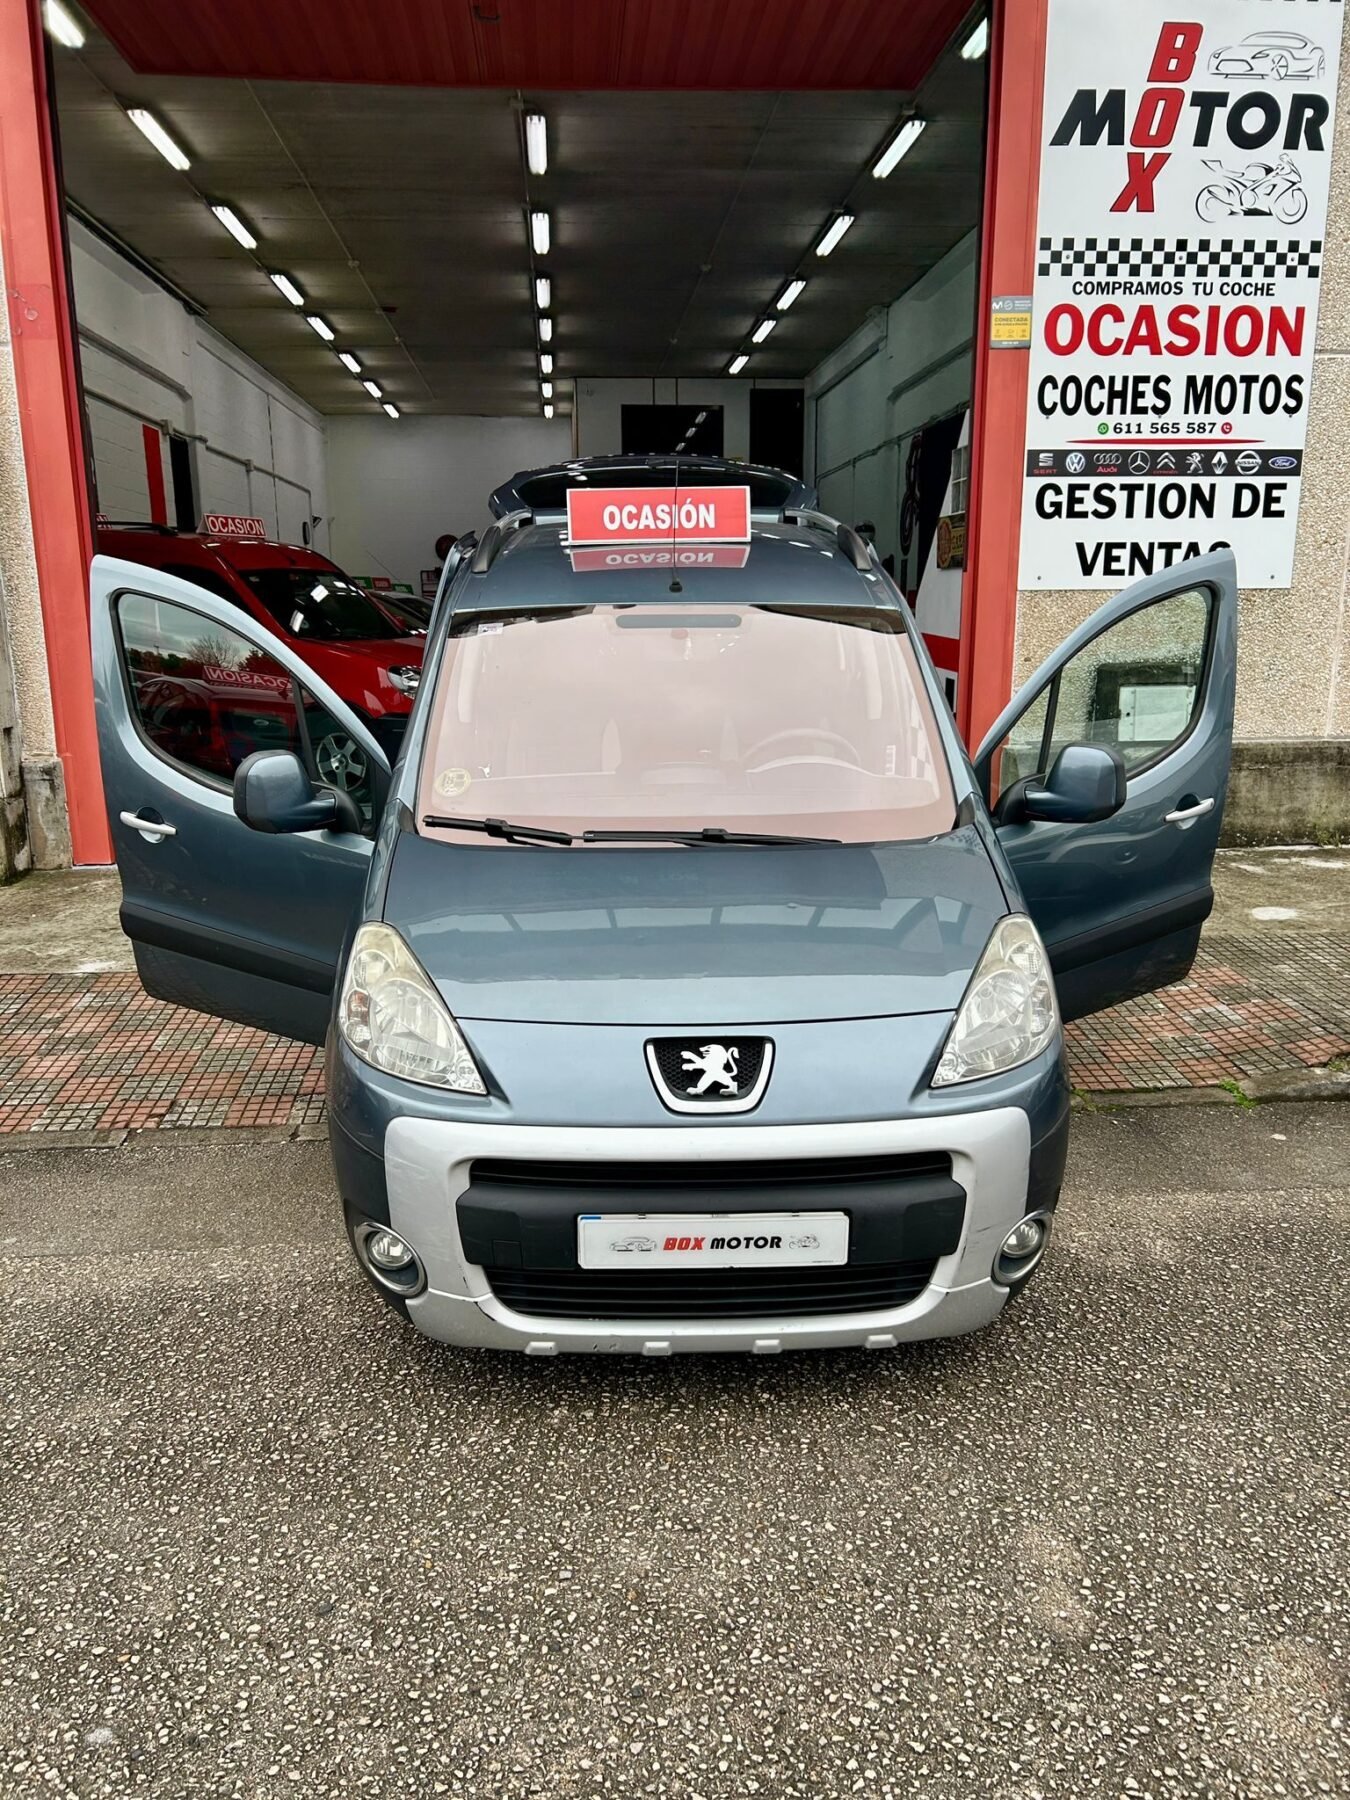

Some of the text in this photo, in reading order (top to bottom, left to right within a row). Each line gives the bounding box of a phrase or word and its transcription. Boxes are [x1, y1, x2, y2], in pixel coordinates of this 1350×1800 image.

[1049, 88, 1330, 151] MOTOR
[1109, 22, 1204, 213] BOX
[1072, 281, 1276, 297] COMPRAMOS TU COCHE
[1043, 303, 1306, 357] OCASION
[1037, 374, 1304, 416] COCHES MOTOS
[1113, 423, 1216, 434] 611 565 587
[1274, 459, 1292, 467] Ford
[603, 498, 716, 530] OCASIÓN
[1035, 483, 1288, 519] GESTION DE
[208, 516, 264, 535] OCASION
[663, 1236, 783, 1251] BOX MOTOR
